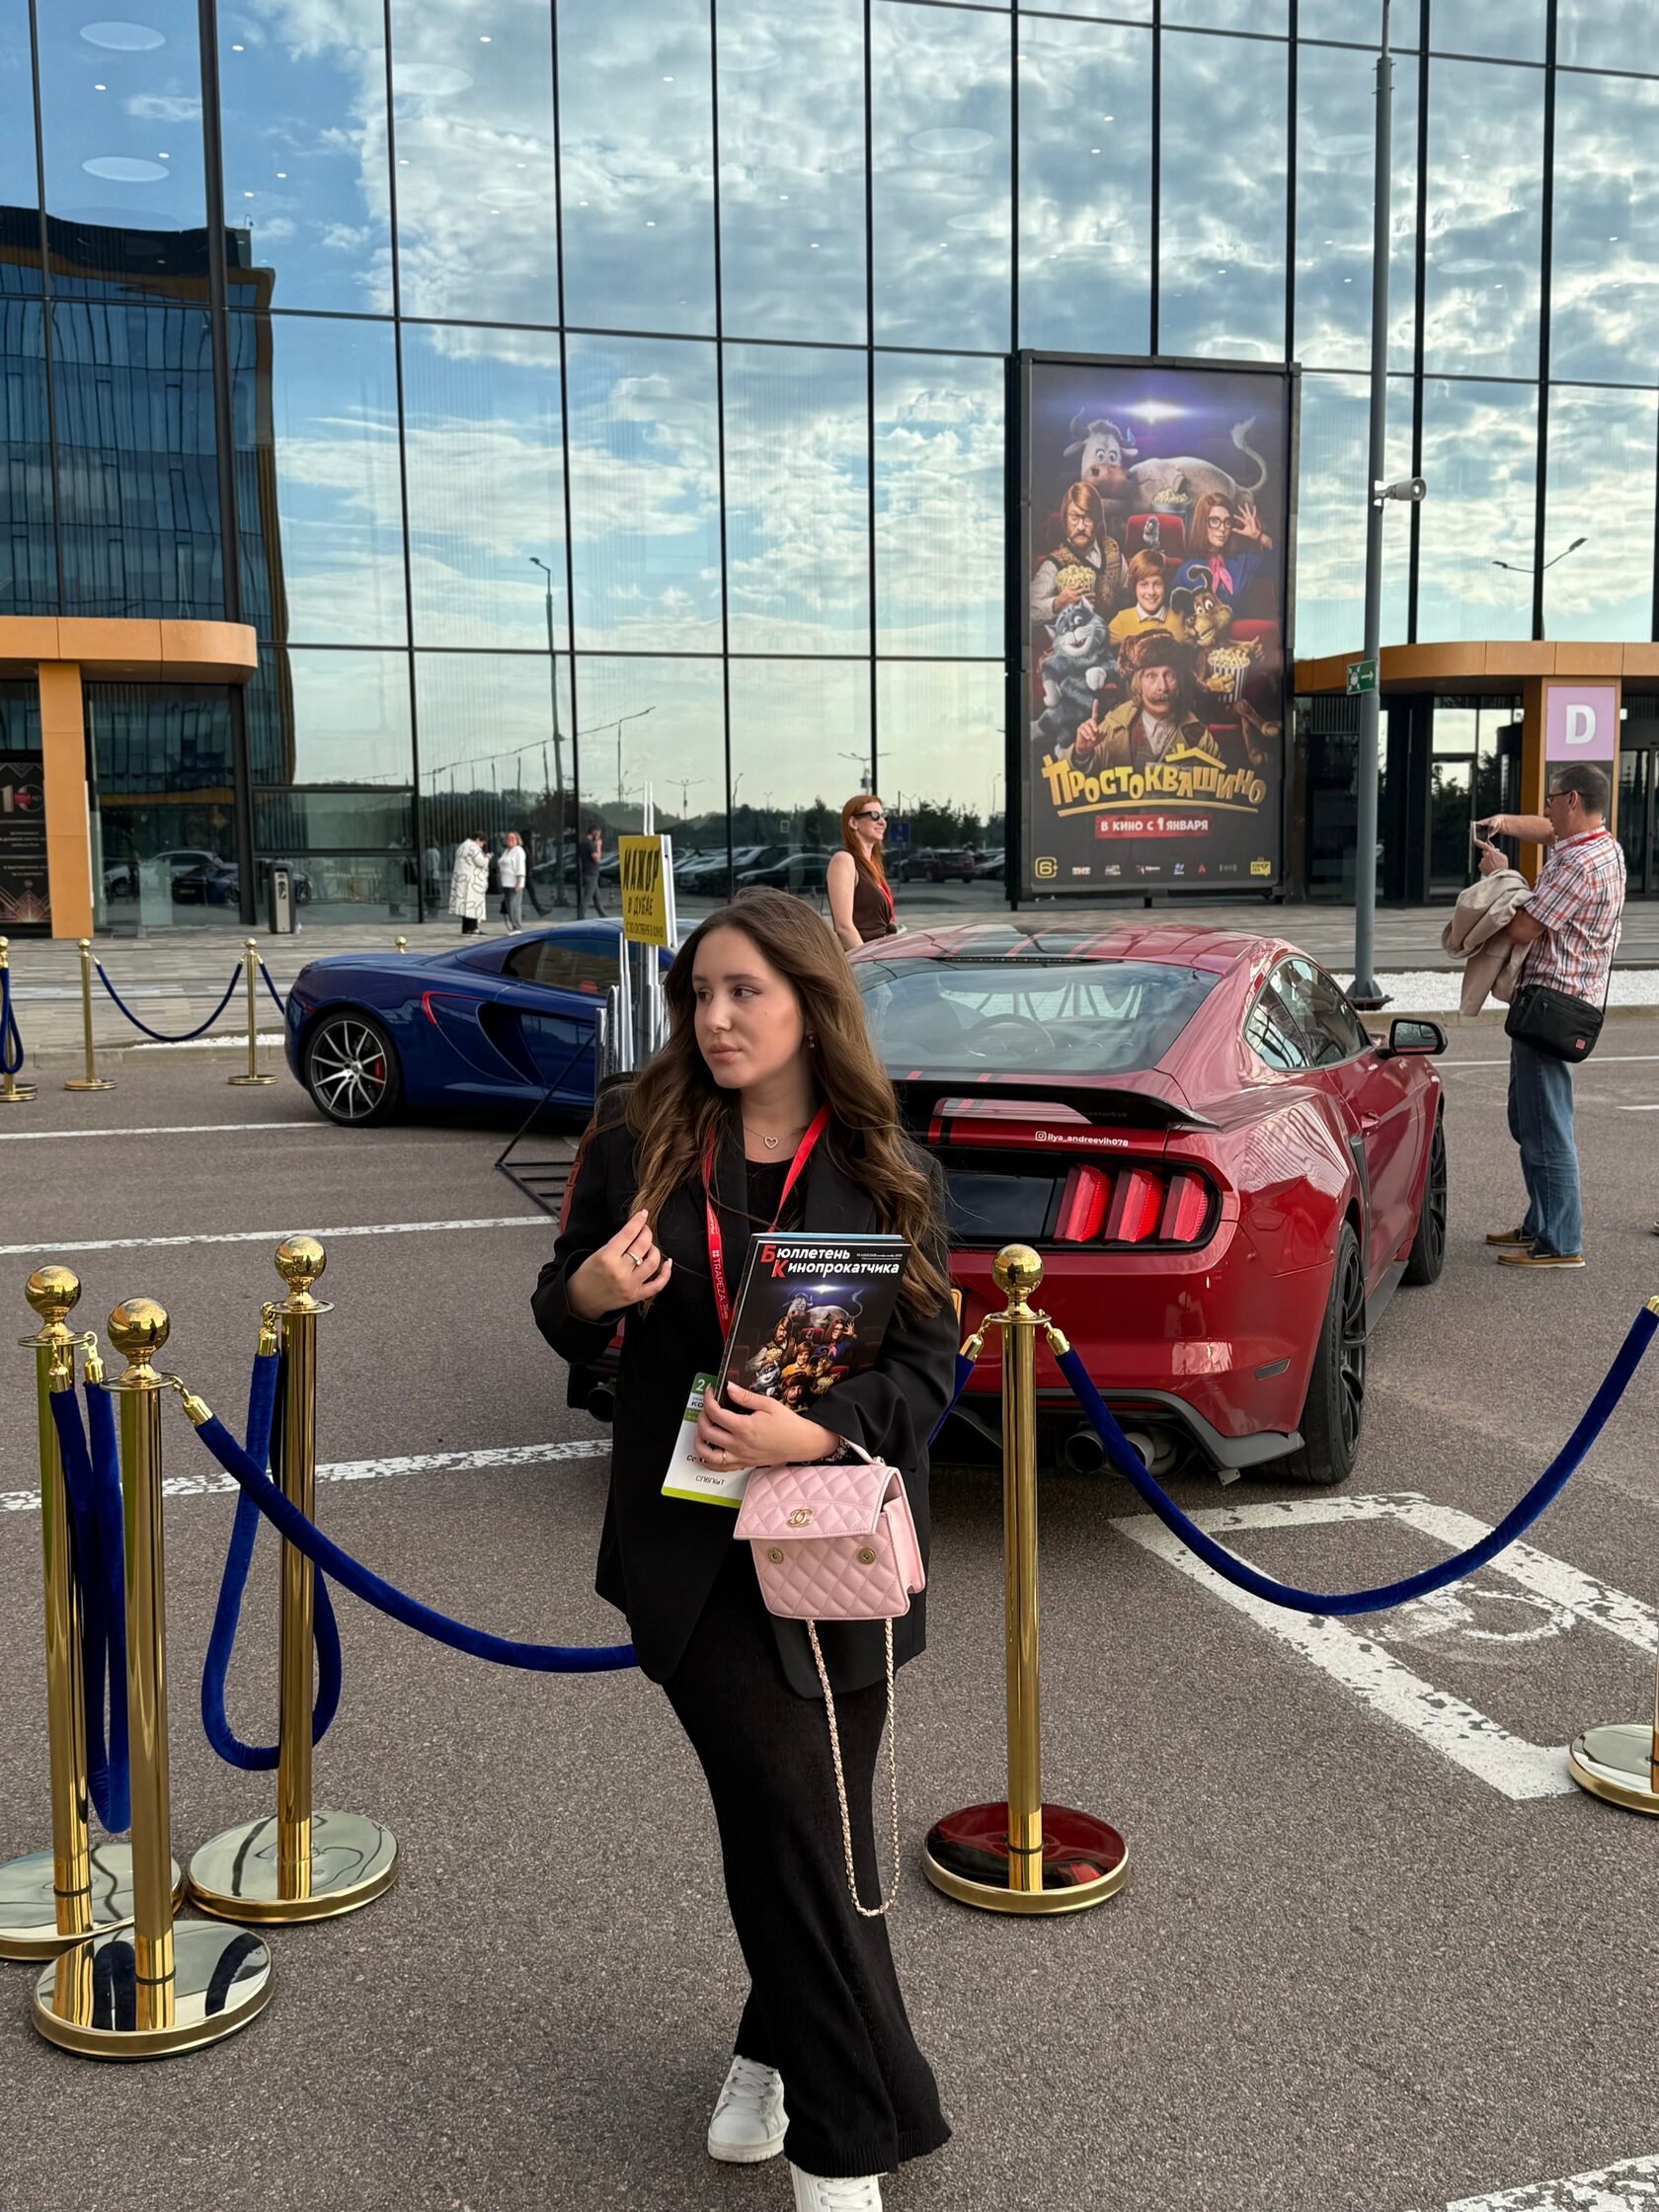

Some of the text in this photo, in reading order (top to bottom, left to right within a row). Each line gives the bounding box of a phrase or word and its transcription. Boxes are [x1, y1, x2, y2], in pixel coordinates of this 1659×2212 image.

[1565, 704, 1597, 745] D
[1042, 754, 1267, 806] ПРОСТОКВАШИНО
[1100, 817, 1209, 832] В КИНО С 1 ЯНВАРЯ
[759, 1244, 851, 1263] Бюллетень
[770, 1258, 900, 1279] Кинопрокатчика
[712, 1257, 727, 1303] TRAPEZA
